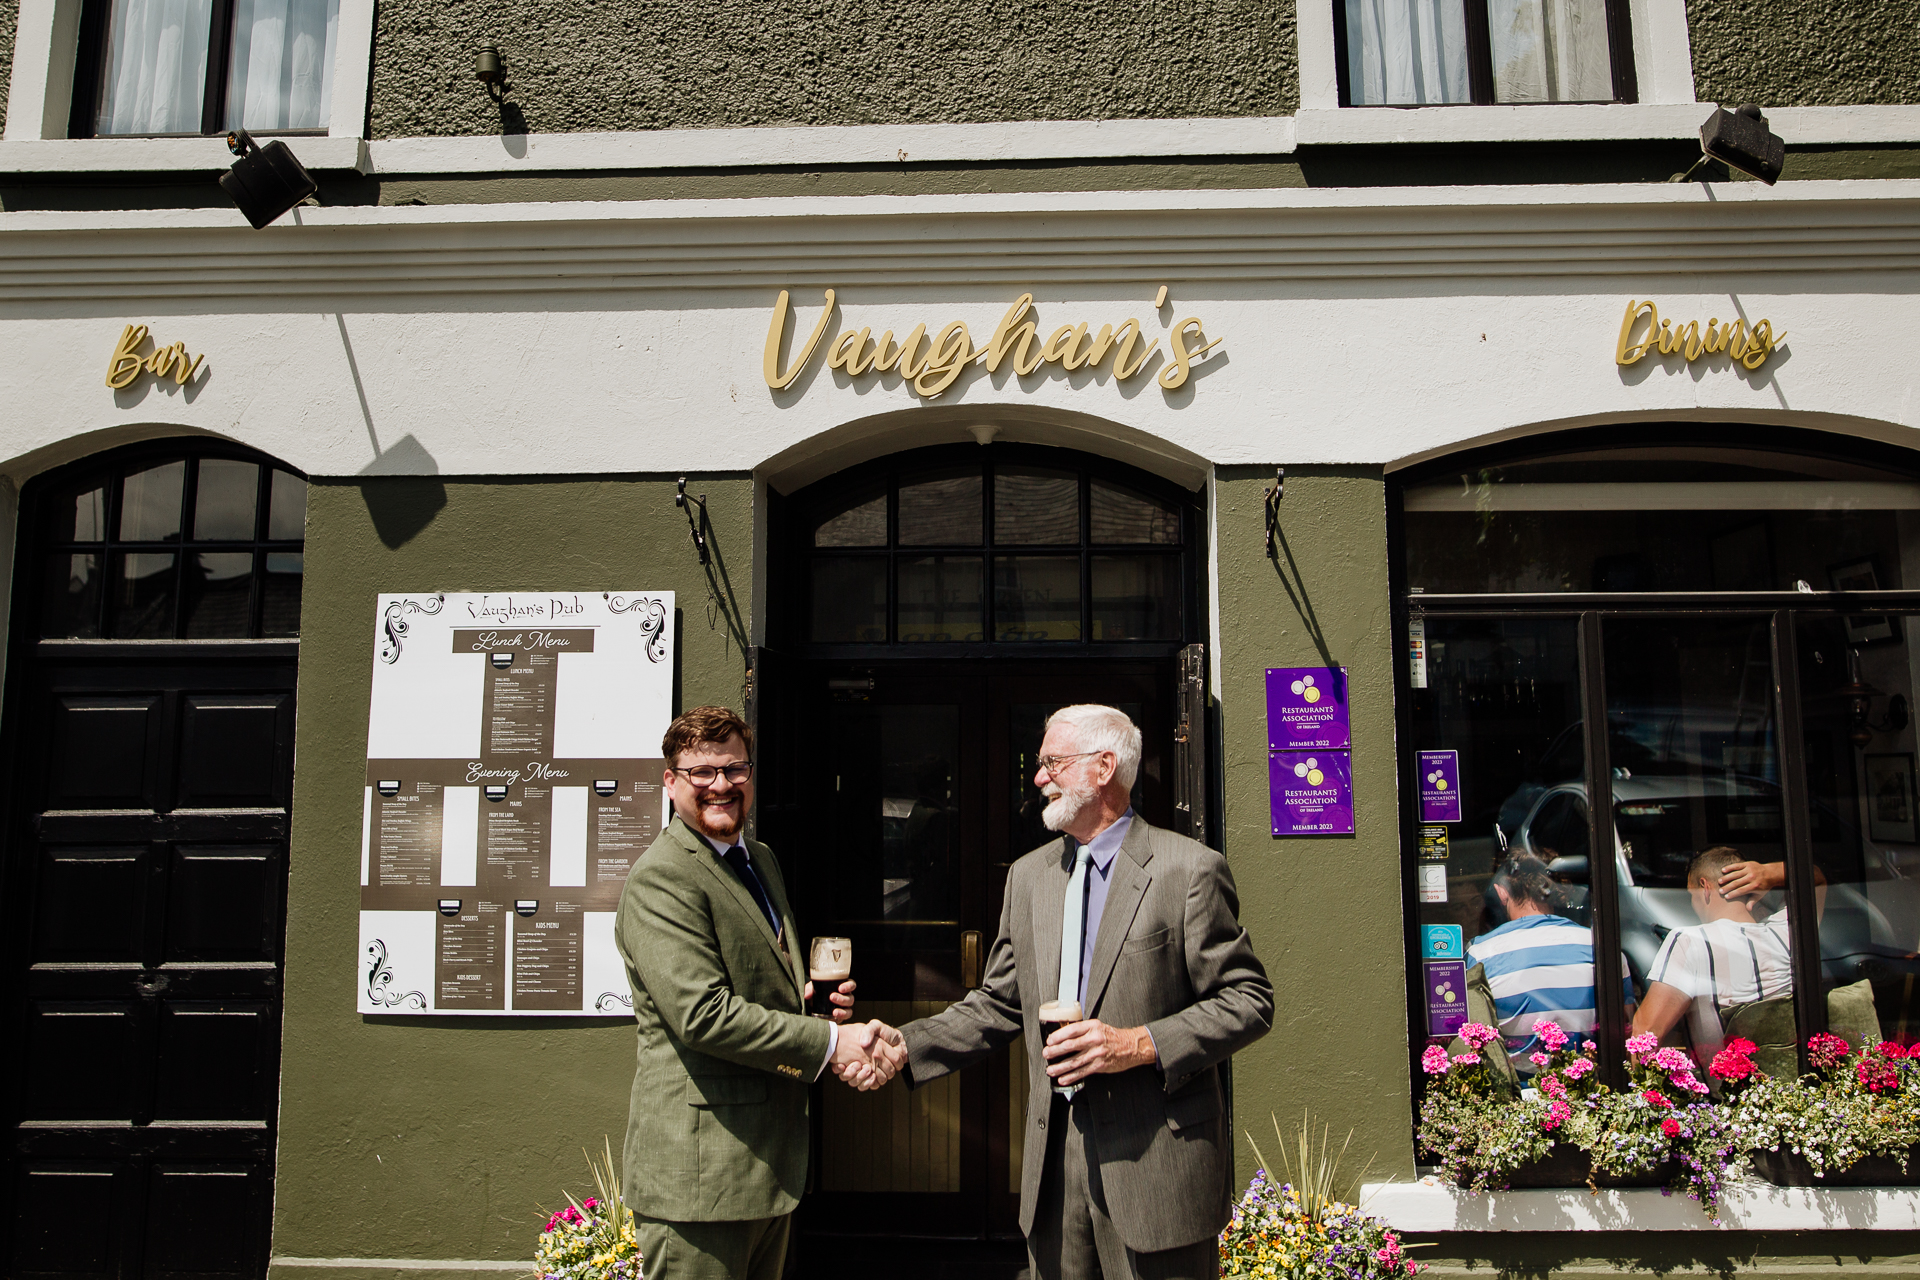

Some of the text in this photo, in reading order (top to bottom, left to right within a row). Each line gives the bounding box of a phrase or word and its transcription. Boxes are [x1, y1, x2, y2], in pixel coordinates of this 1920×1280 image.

[763, 285, 1223, 397] Vaughan's
[1615, 299, 1788, 371] Dining
[105, 323, 205, 390] Bar
[466, 595, 584, 624] Vaughan's Pub
[472, 631, 570, 650] Lunch Menu
[1281, 705, 1334, 714] RESTAURANTS
[1281, 713, 1334, 722] ASSOCIATION
[1315, 739, 1330, 747] 2022
[465, 762, 570, 785] Evening Menu
[1284, 788, 1338, 797] RESTAURANTS
[1284, 797, 1337, 805] ASSOCIATION
